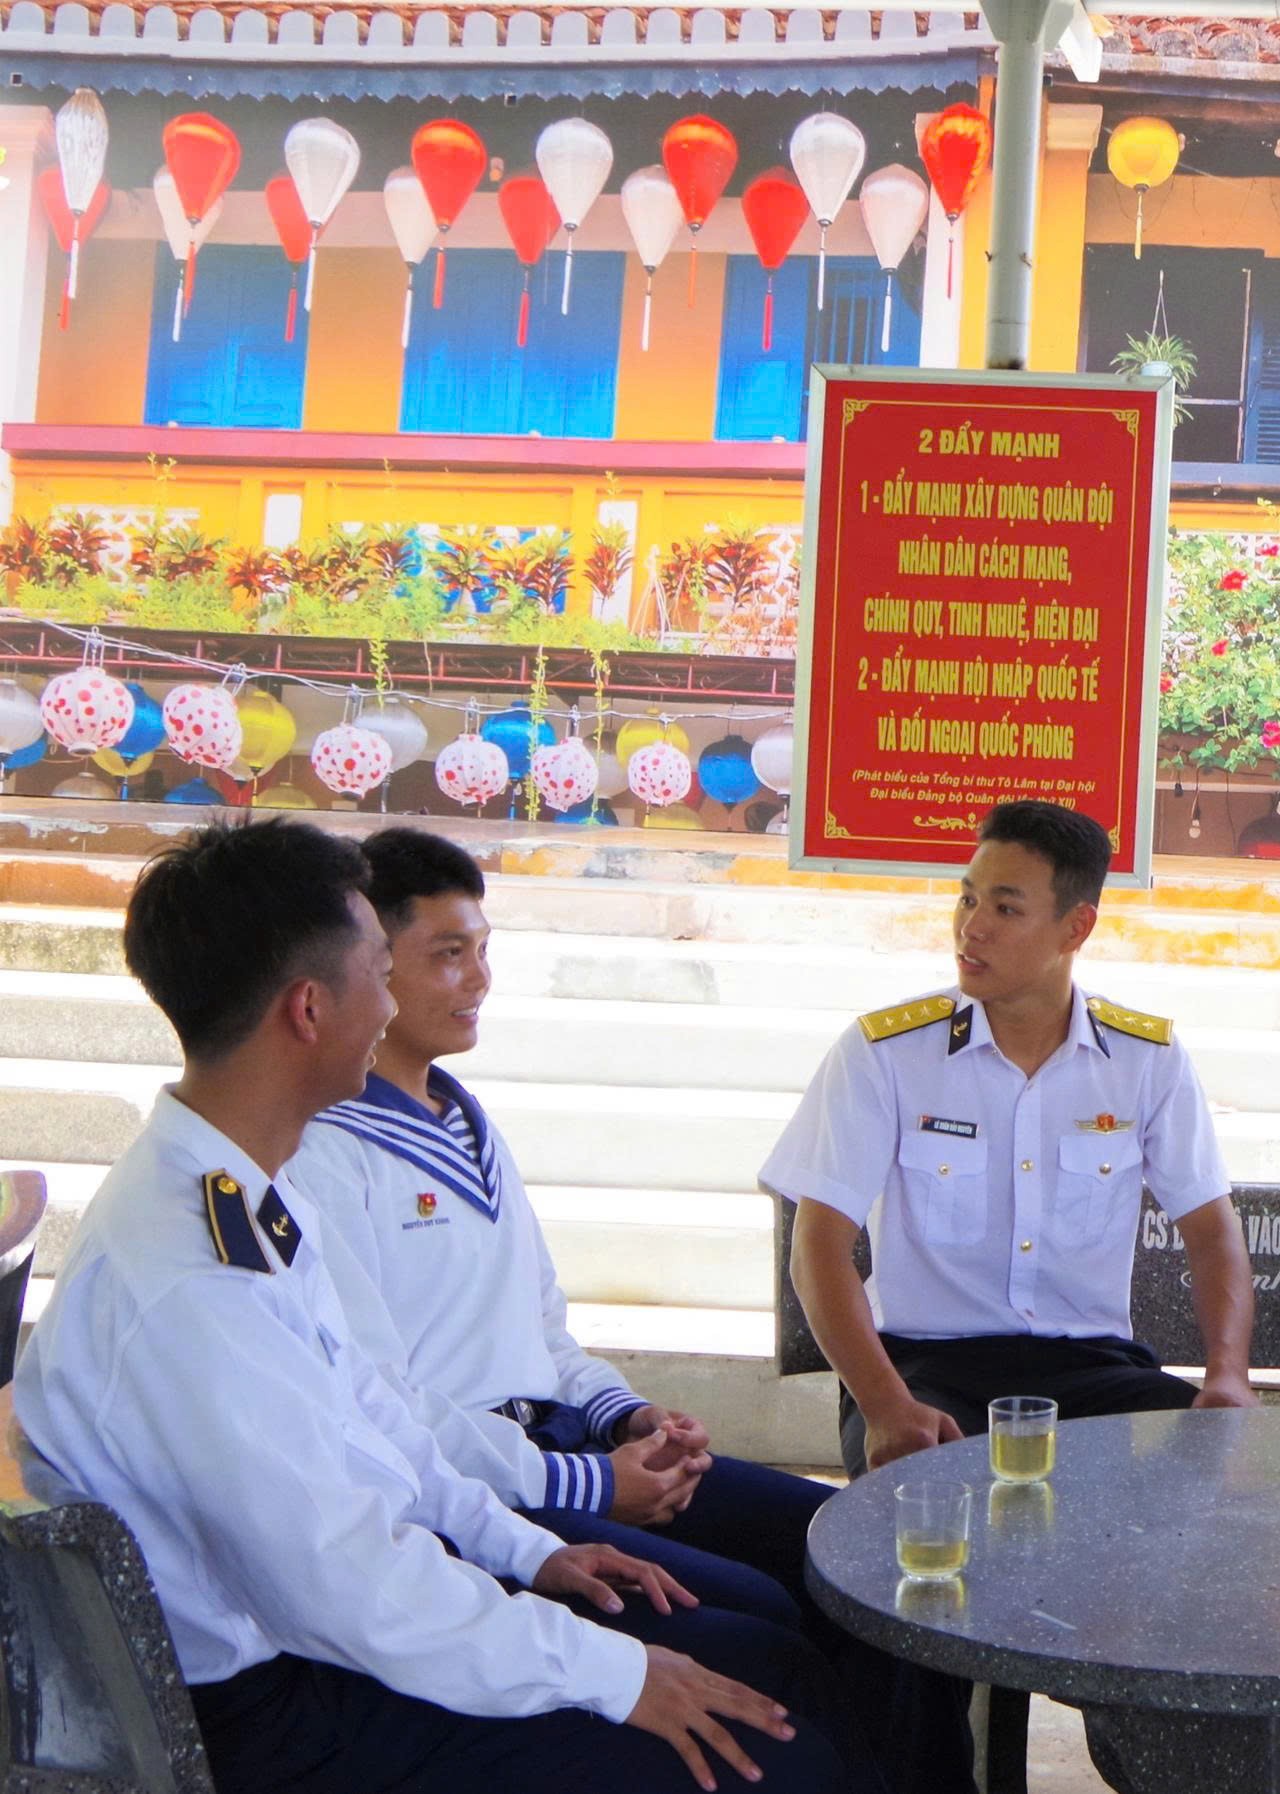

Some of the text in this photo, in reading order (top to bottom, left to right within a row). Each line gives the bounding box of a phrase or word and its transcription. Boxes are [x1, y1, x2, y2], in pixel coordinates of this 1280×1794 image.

[918, 421, 1060, 462] 2 ĐẨY MẠNH
[861, 480, 868, 513] 1
[883, 467, 913, 515] ĐẨY
[916, 482, 962, 524] MẠNH
[964, 477, 994, 518] XÂY
[998, 482, 1039, 527] DỰNG
[1042, 480, 1084, 525] QUÂN
[1088, 482, 1114, 531] ĐỘI
[898, 534, 1072, 588] NHÂN DÂN CÁCH MẠNG,
[864, 592, 1099, 649] CHÍNH QUY, TINH NHUỆ, HIỆN ĐẠI
[858, 656, 868, 691] 2
[881, 644, 911, 692] ĐẨY
[915, 659, 960, 702] MẠNH
[963, 655, 988, 704] HỘI
[992, 657, 1033, 705] NHẬP
[1037, 654, 1077, 703] QUỐC
[1082, 657, 1101, 702] TẾ
[878, 707, 1074, 763] VÀ ĐỐI NGOẠI QUỐC PHÒNG
[852, 770, 882, 782] (Phát
[884, 769, 908, 783] biểu
[910, 771, 930, 784] của
[933, 771, 960, 787] Tổng
[976, 776, 996, 787] thư
[1014, 777, 1037, 789] Lâm
[1040, 779, 1054, 791] tại
[1056, 779, 1074, 793] Đại
[1077, 780, 1096, 793] hội
[870, 787, 889, 800] Đại
[891, 786, 914, 800] biểu
[917, 788, 946, 804] Đảng
[948, 791, 963, 804] bộ
[965, 792, 994, 804] Quân
[1142, 1209, 1169, 1250] CS
